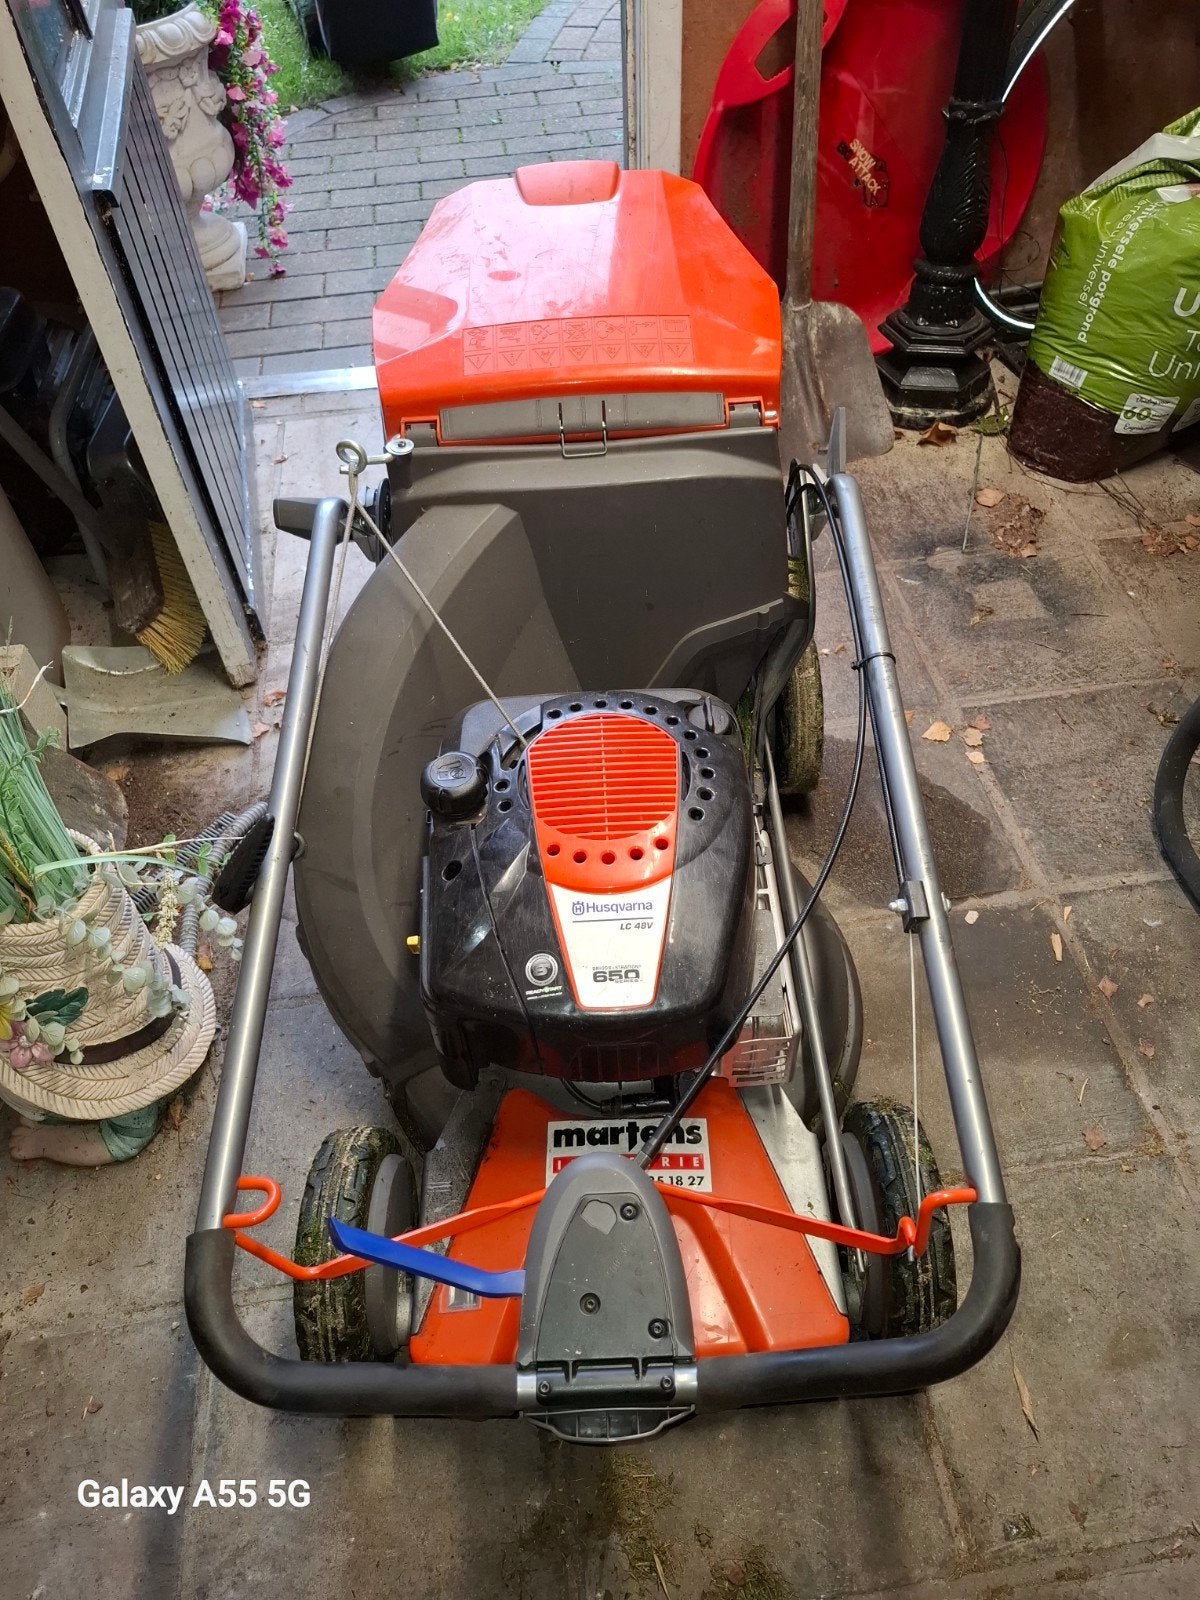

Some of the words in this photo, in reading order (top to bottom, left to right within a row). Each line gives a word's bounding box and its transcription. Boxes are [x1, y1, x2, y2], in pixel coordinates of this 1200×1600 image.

[850, 139, 877, 171] SNOW
[848, 156, 882, 196] ATTACK
[1077, 239, 1112, 307] universel
[1077, 269, 1112, 344] potgrond
[1123, 406, 1152, 421] 60
[586, 901, 653, 914] Husqvarna
[620, 922, 632, 930] LC
[634, 921, 653, 930] 48V
[592, 969, 640, 983] 650
[553, 1121, 703, 1152] martens
[669, 1175, 684, 1186] 18
[687, 1175, 705, 1186] 27
